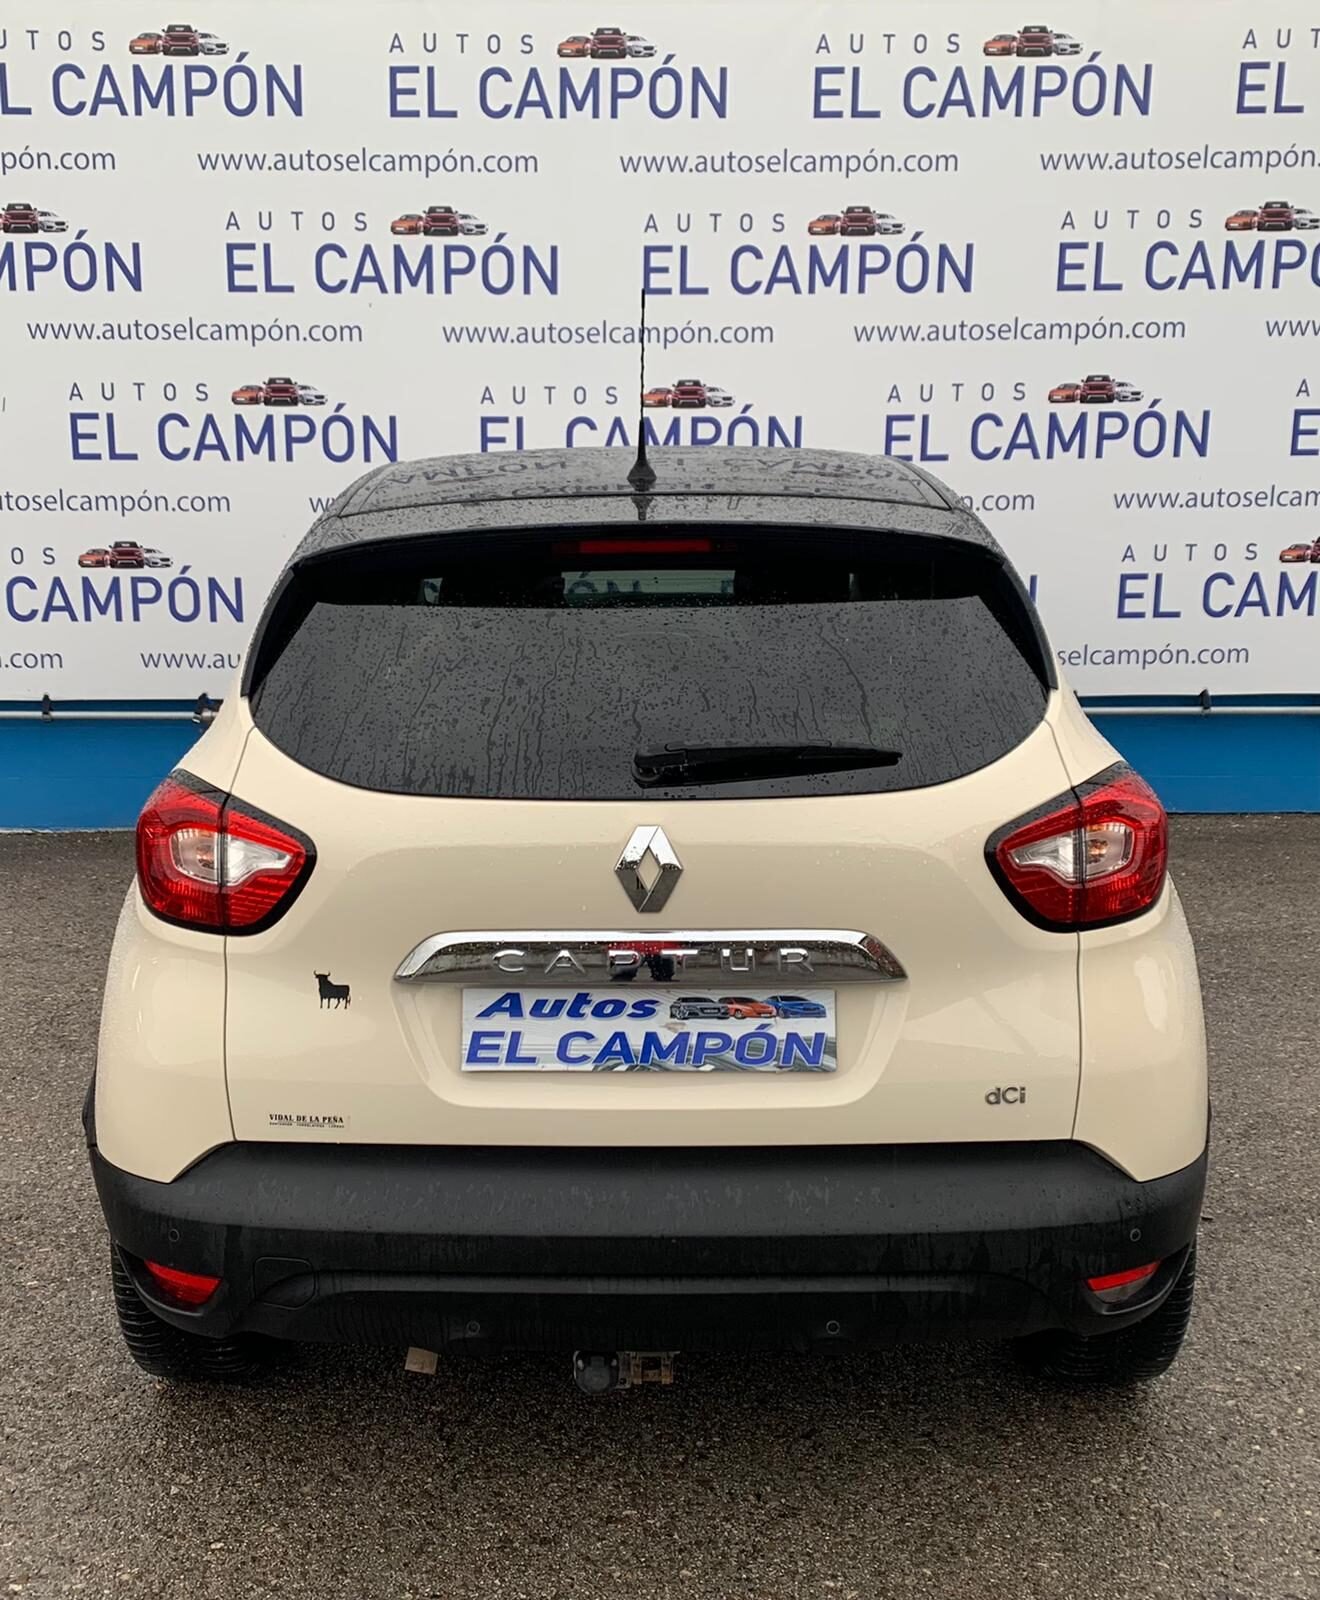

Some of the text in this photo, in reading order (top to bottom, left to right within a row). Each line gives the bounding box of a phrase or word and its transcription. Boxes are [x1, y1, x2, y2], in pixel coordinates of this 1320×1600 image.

[389, 33, 533, 54] AUTOS
[816, 33, 959, 54] AUTOS
[52, 52, 303, 117] CAMPÓN
[389, 54, 727, 119] EL CAMPÓN
[813, 52, 1152, 119] EL CAMPÓN
[1236, 62, 1304, 114] EL
[1, 145, 115, 175] pón.com
[197, 147, 538, 178] www.autoselcampón.com
[620, 148, 958, 178] www.autoselcampón.com
[1040, 143, 1320, 174] www.autoselcampón.
[226, 211, 367, 231] AUTOS
[644, 213, 784, 233] AUTOS
[1061, 209, 1202, 230] AUTOS
[226, 233, 558, 295] EL CAMPÓN
[643, 231, 974, 295] EL CAMPÓN
[1056, 242, 1123, 292] EL
[27, 317, 362, 347] www.autoselcampón.com
[442, 319, 774, 350] www.autoselcampón.com
[854, 316, 1185, 345] www.autoselcampón.com
[69, 382, 208, 401] AUTOS
[481, 386, 617, 405] AUTOS
[888, 382, 1025, 403] AUTOS
[70, 403, 398, 463] EL CAMPÓN
[883, 400, 1210, 462] EL CAMPÓN
[0, 488, 231, 517] toselcampón.com
[1121, 543, 1257, 562] AUTOS
[6, 566, 244, 623] CAMPÓN
[1117, 573, 1181, 619] EL
[0, 652, 64, 669] .com
[492, 949, 814, 974] CAPTUR
[474, 991, 660, 1020] Autos
[464, 1023, 829, 1067] EL CAMPÓN
[984, 1086, 1027, 1106] dCi
[269, 1113, 294, 1121] VIDAL
